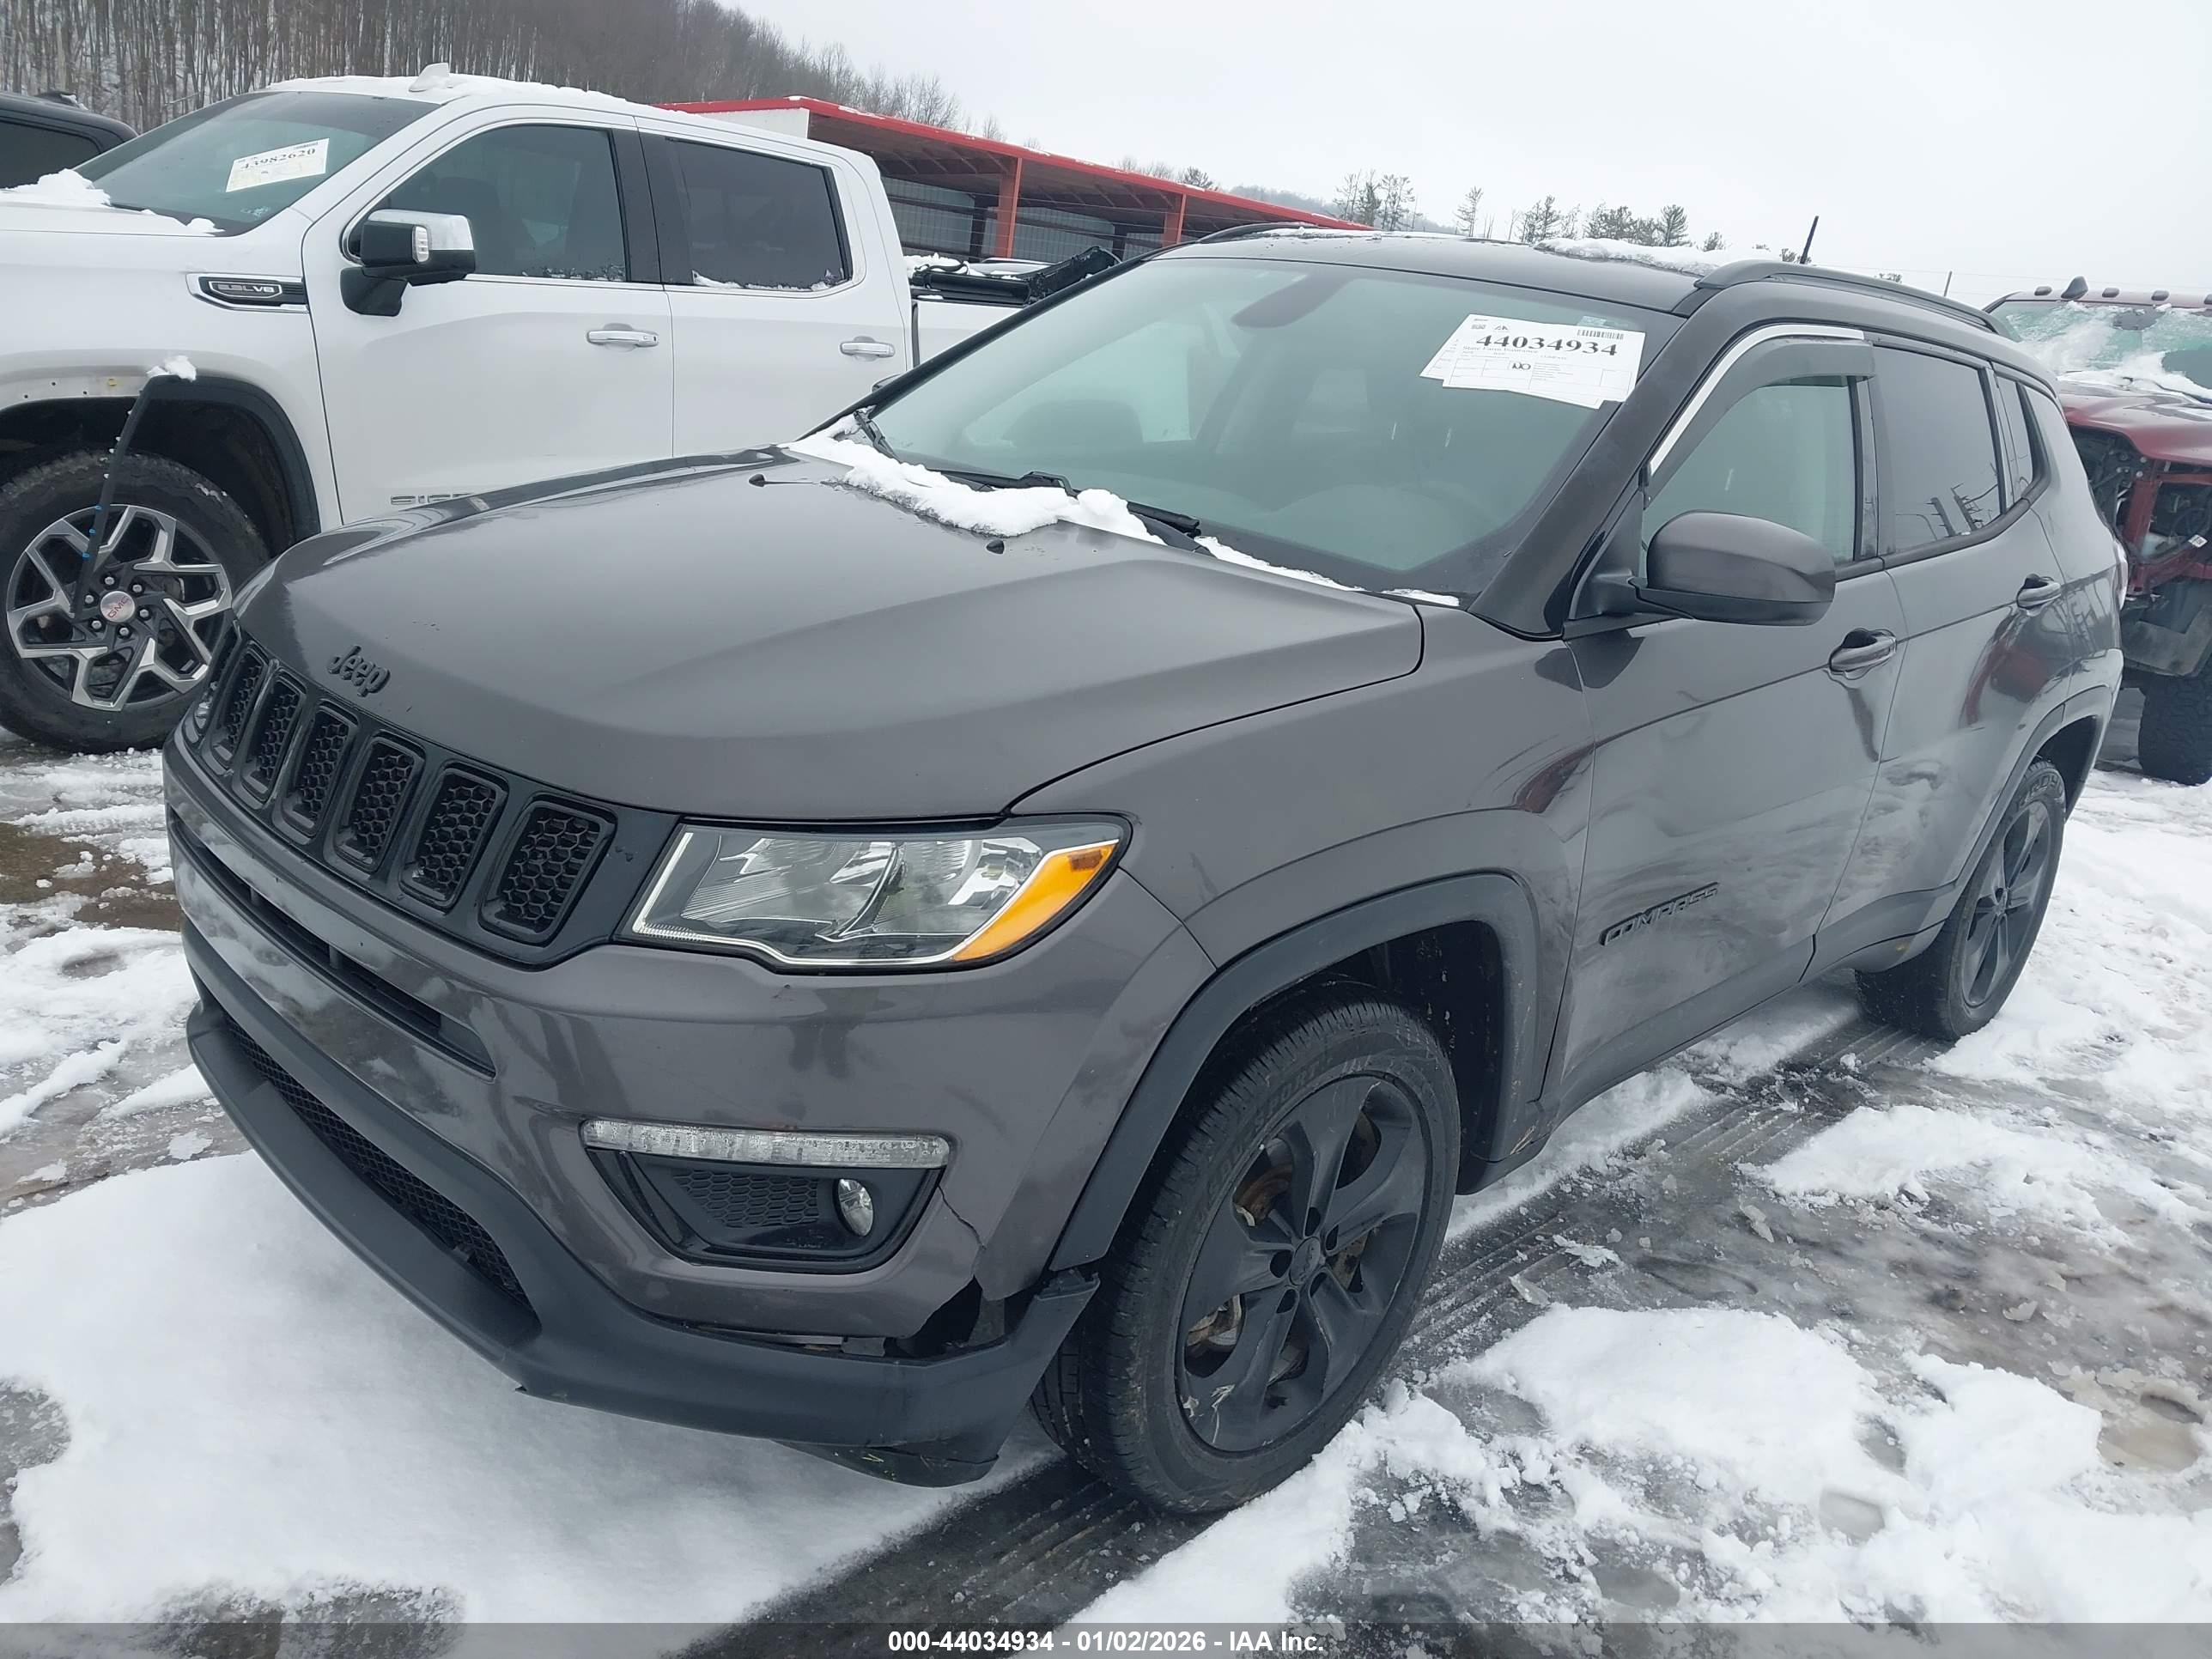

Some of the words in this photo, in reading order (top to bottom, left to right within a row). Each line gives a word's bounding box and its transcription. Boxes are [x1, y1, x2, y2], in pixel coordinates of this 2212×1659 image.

[1475, 334, 1618, 356] 44034934
[106, 595, 130, 618] GMC
[327, 645, 391, 698] Jeep
[1598, 881, 1720, 946] COMPASS
